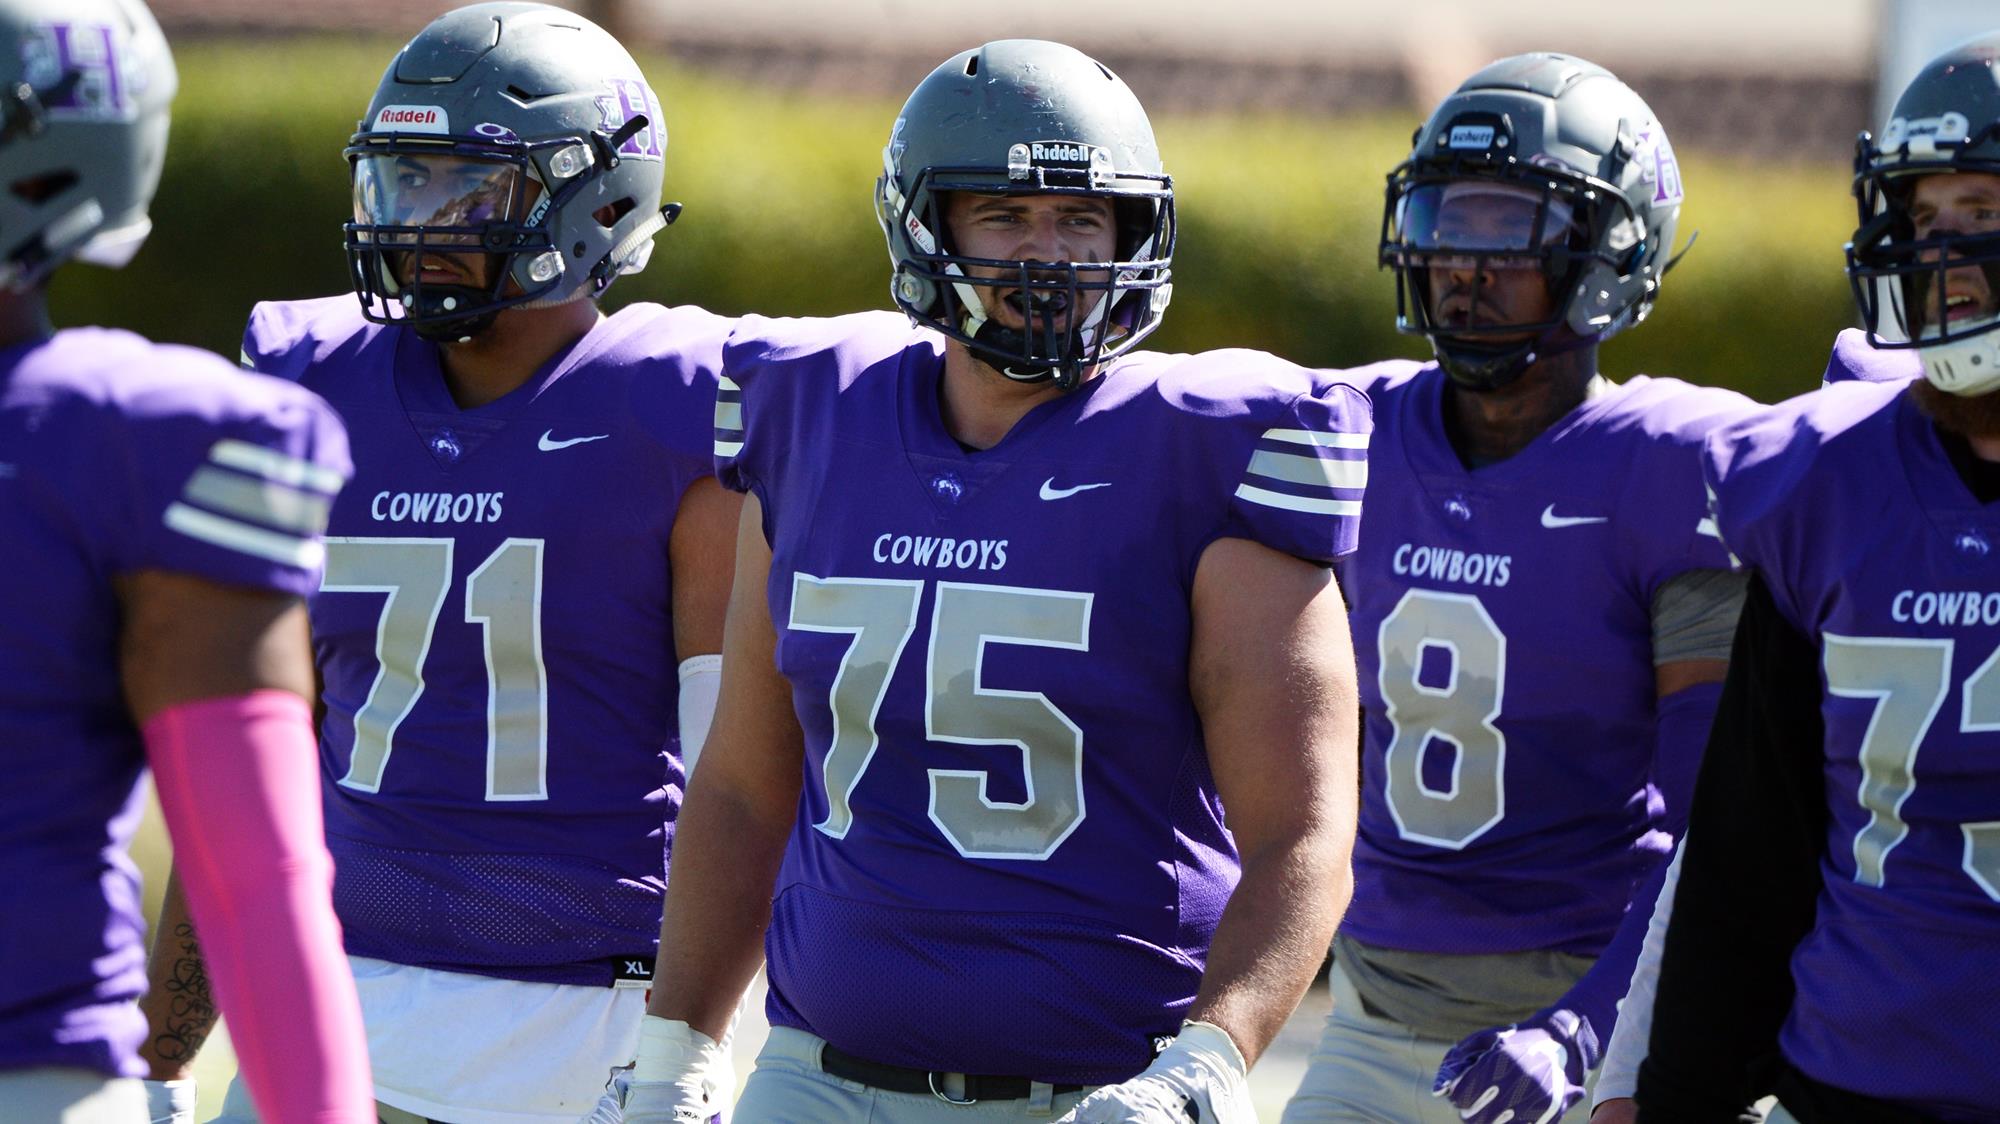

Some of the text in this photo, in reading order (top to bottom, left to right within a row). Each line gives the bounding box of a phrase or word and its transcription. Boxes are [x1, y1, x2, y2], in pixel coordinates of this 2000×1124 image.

[380, 109, 437, 124] Riddell
[1031, 143, 1089, 162] Riddell
[371, 490, 504, 523] COWBOYS
[873, 533, 1009, 571] COWBOYS
[1393, 543, 1512, 587] COWBOYS
[1891, 589, 2000, 626] COWBO
[319, 536, 549, 802] 71
[787, 571, 1095, 861] 75
[1378, 587, 1507, 851] 8
[624, 960, 651, 975] XL
